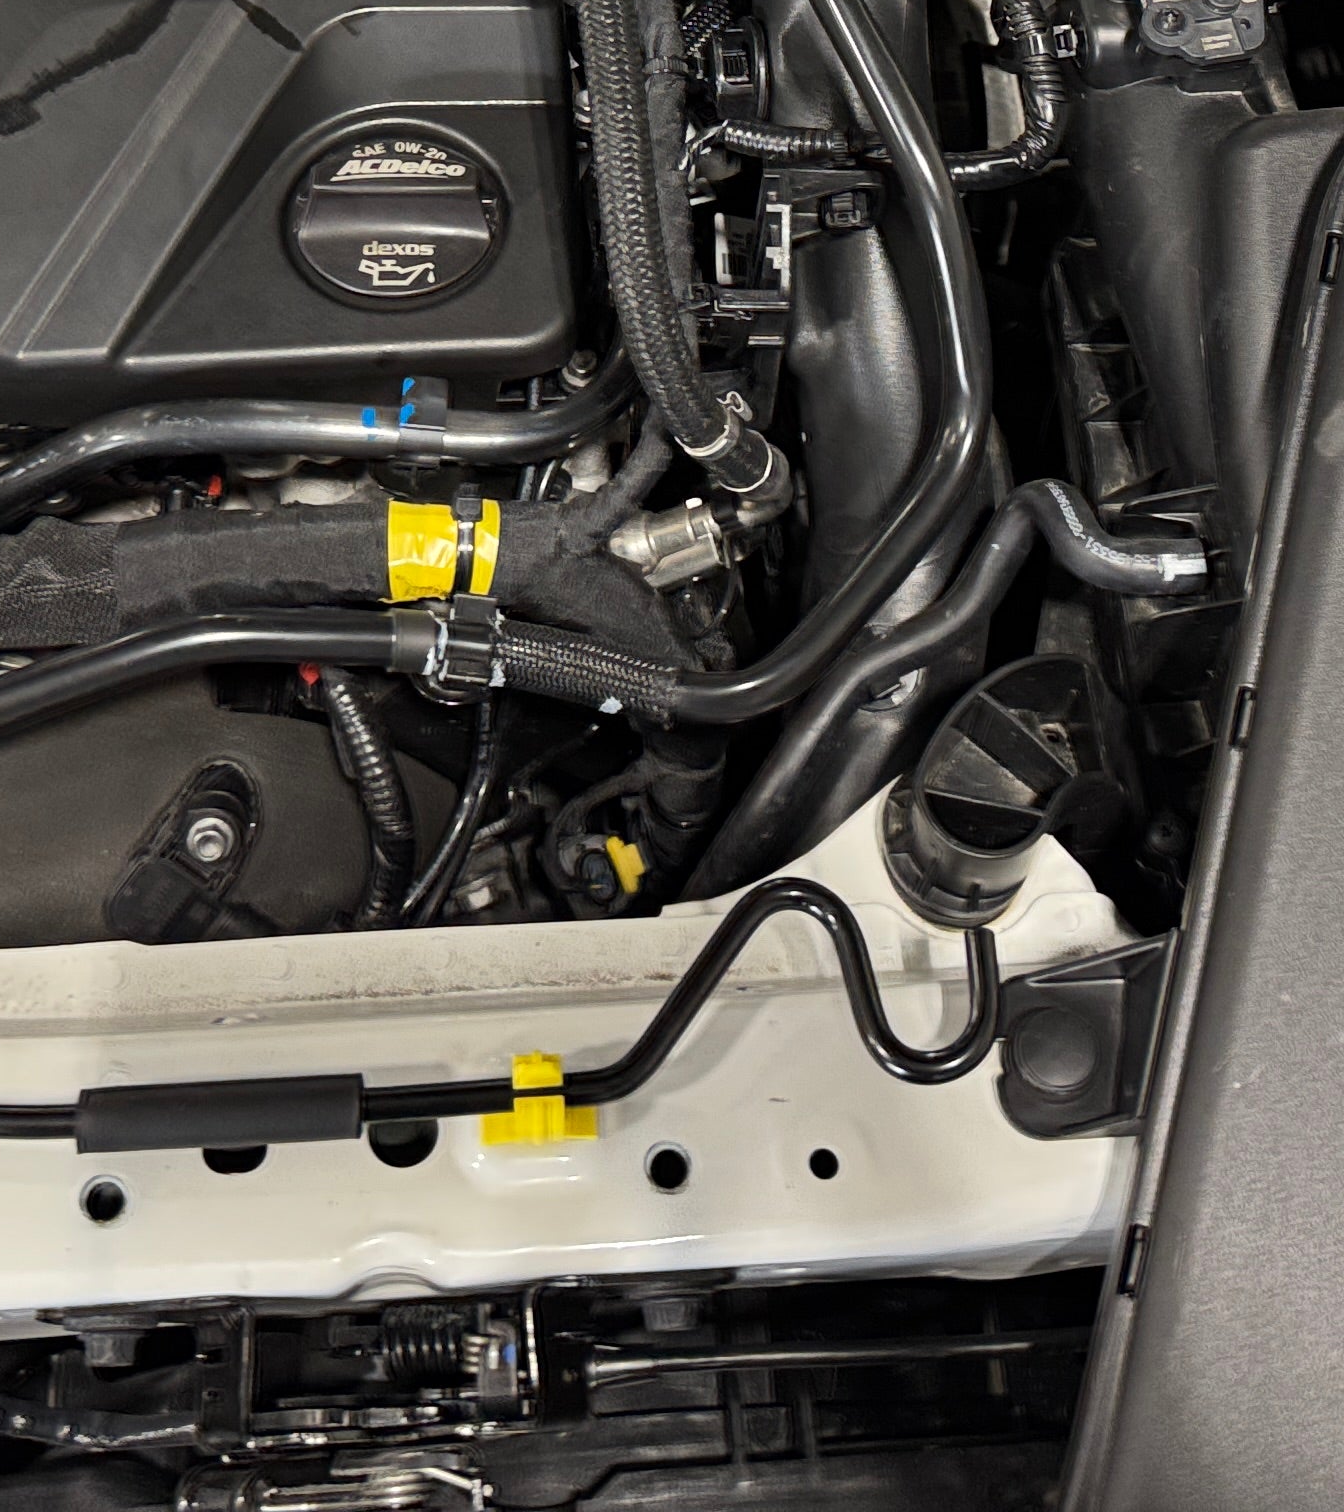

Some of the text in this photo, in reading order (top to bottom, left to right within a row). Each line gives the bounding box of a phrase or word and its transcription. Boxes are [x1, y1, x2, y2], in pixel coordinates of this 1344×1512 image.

[352, 142, 386, 158] SAE
[336, 159, 467, 177] ACDelco
[362, 241, 437, 256] dexos
